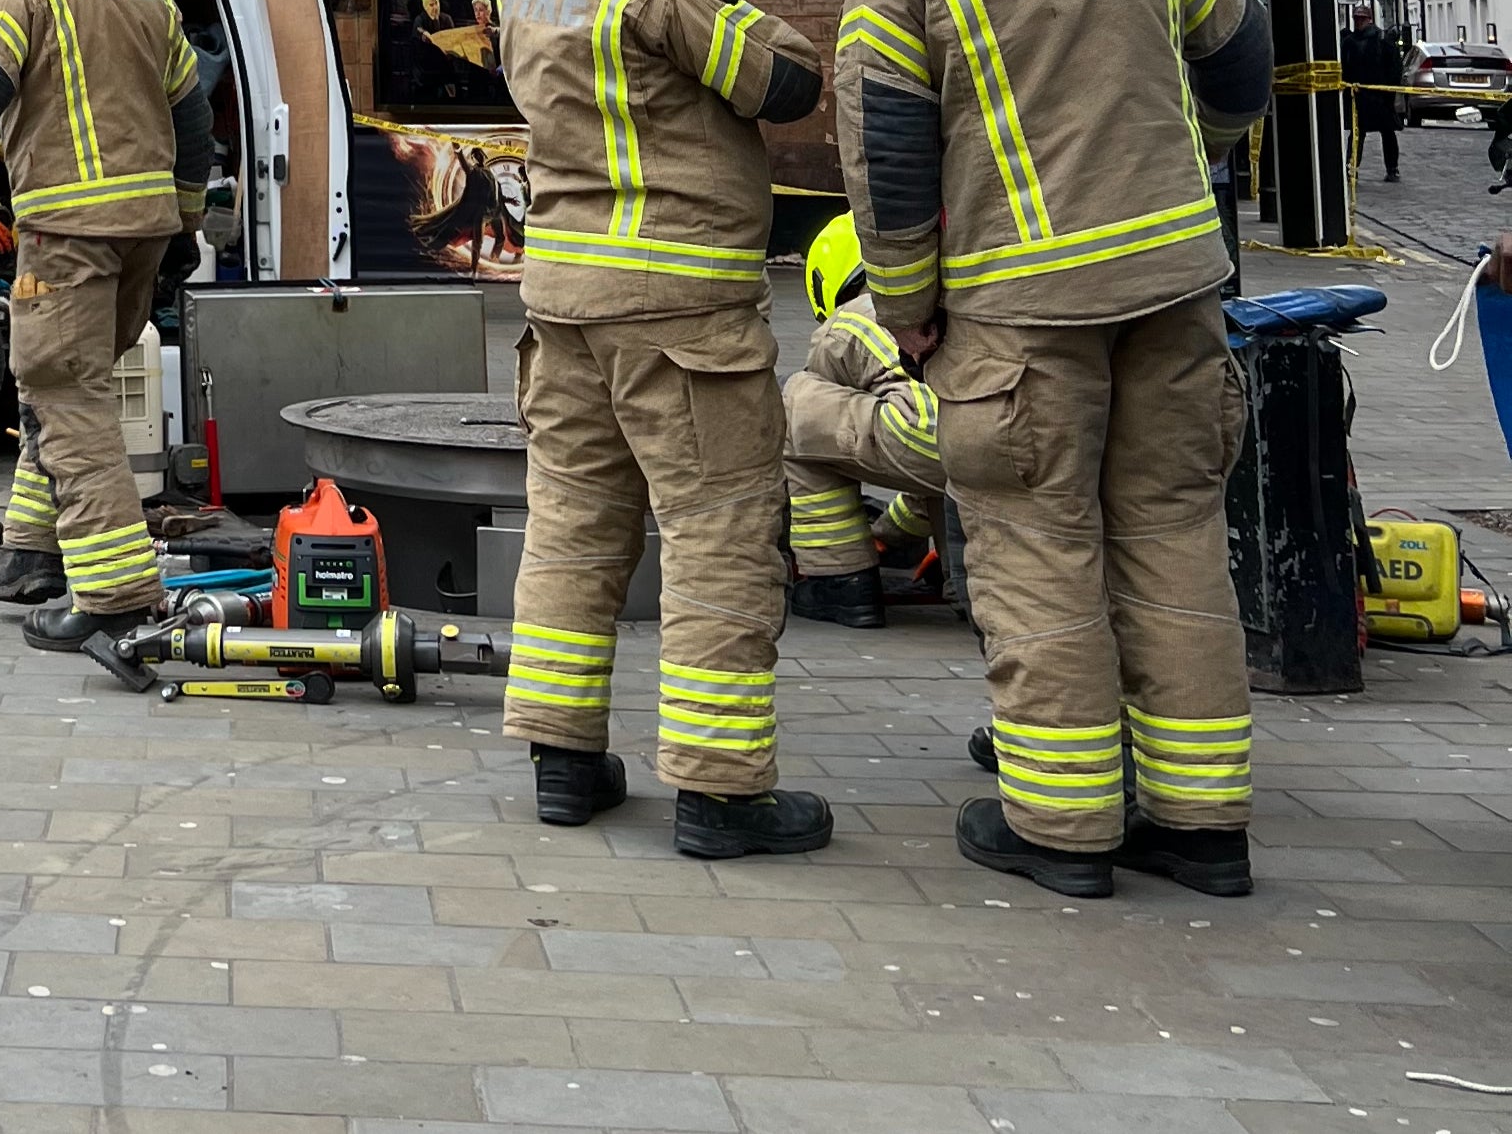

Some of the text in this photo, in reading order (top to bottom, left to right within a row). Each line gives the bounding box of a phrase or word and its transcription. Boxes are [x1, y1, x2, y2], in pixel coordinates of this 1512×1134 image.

[1400, 539, 1428, 551] ZOLL
[1375, 558, 1423, 580] AED
[315, 570, 354, 581] holmatro
